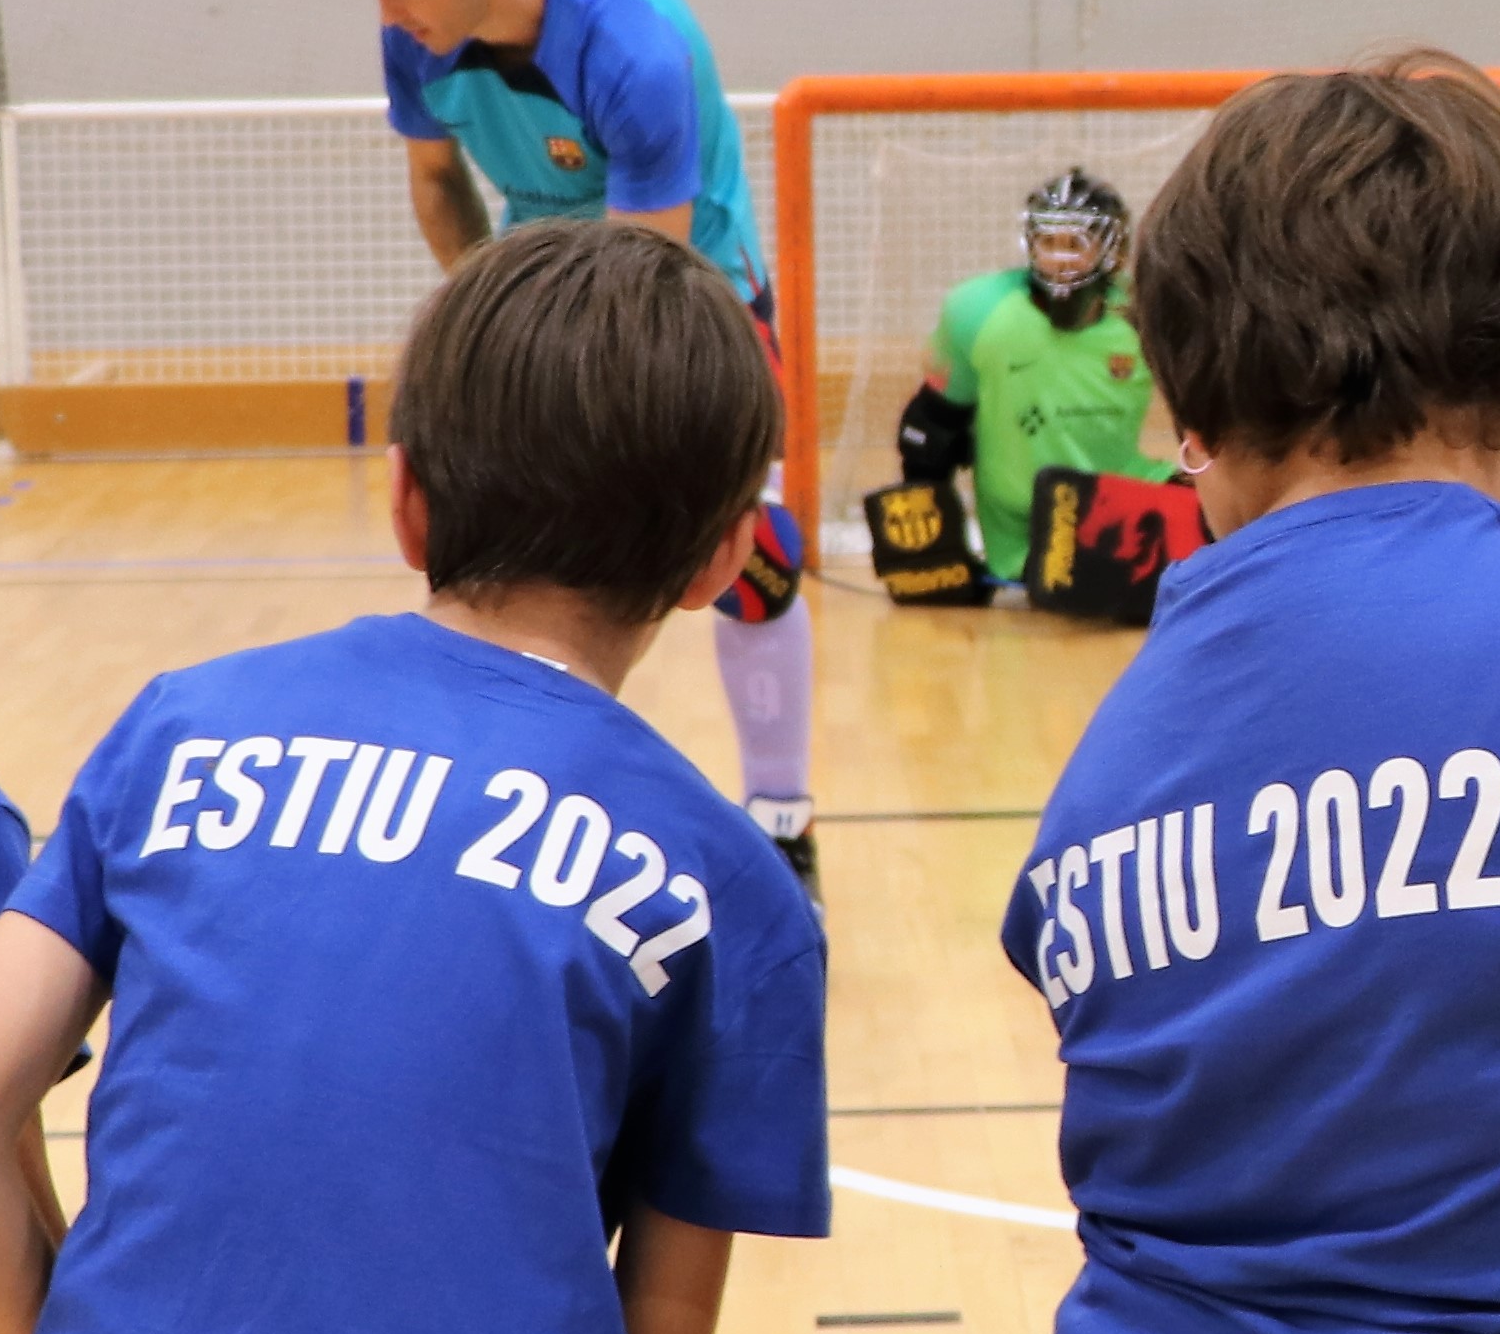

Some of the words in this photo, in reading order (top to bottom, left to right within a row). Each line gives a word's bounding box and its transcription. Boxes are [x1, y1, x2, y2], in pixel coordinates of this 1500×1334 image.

[138, 735, 454, 864] ESTIU
[455, 767, 713, 998] 2022
[1027, 802, 1221, 1009] ESTIU
